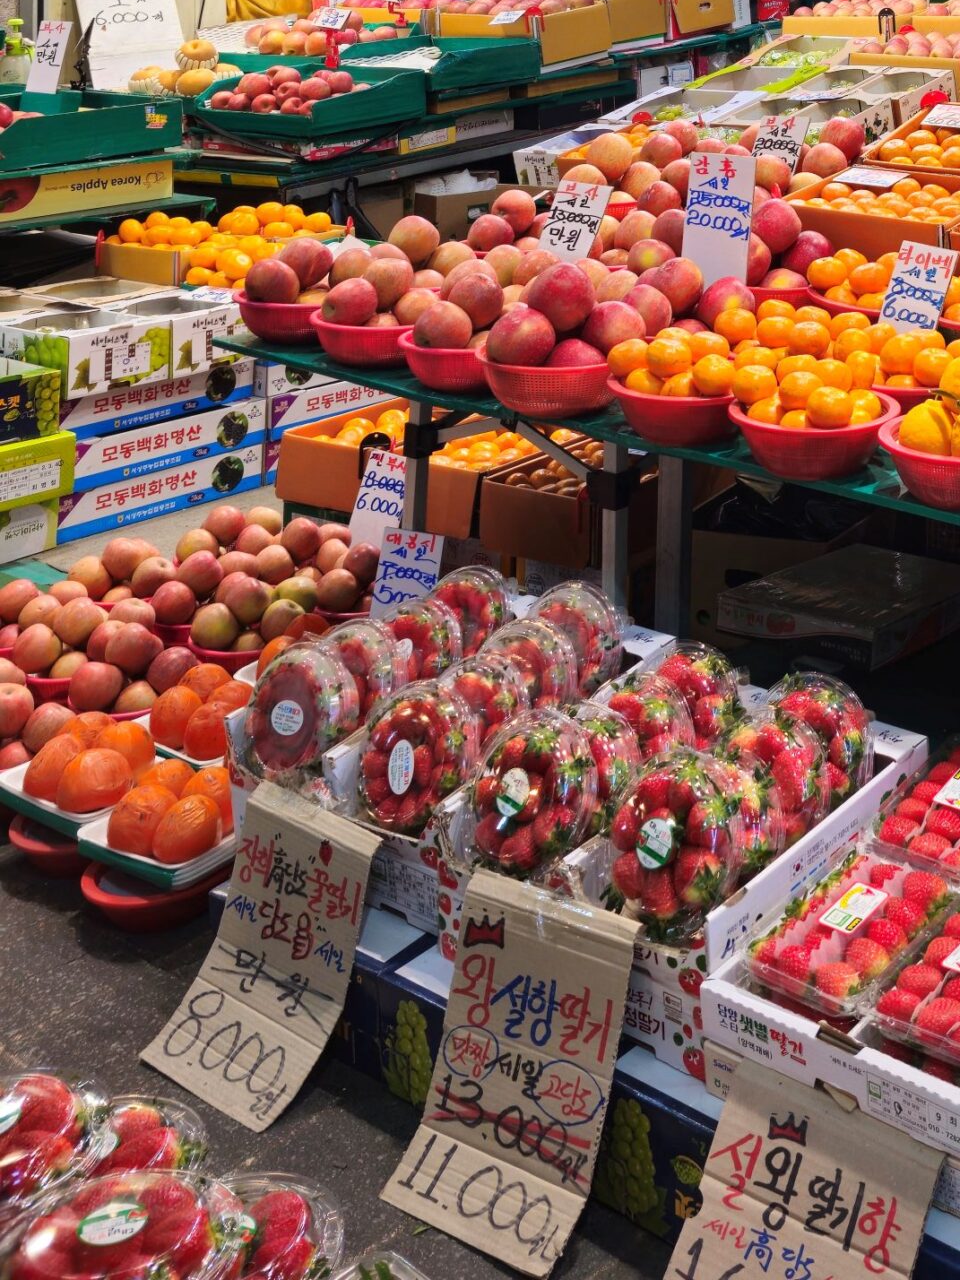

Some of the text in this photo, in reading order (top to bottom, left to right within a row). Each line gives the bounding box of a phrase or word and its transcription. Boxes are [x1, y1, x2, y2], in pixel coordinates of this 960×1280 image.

[36, 49, 60, 67] 만원
[693, 155, 737, 178] 감홍
[70, 175, 142, 193] Korea Apples
[698, 177, 730, 191] 세일
[548, 228, 583, 251] 만원
[385, 533, 436, 552] 대봉시
[227, 894, 257, 923] 세일
[314, 940, 347, 973] 세일
[540, 1074, 591, 1120] 고당도
[703, 1217, 749, 1249] 세일
